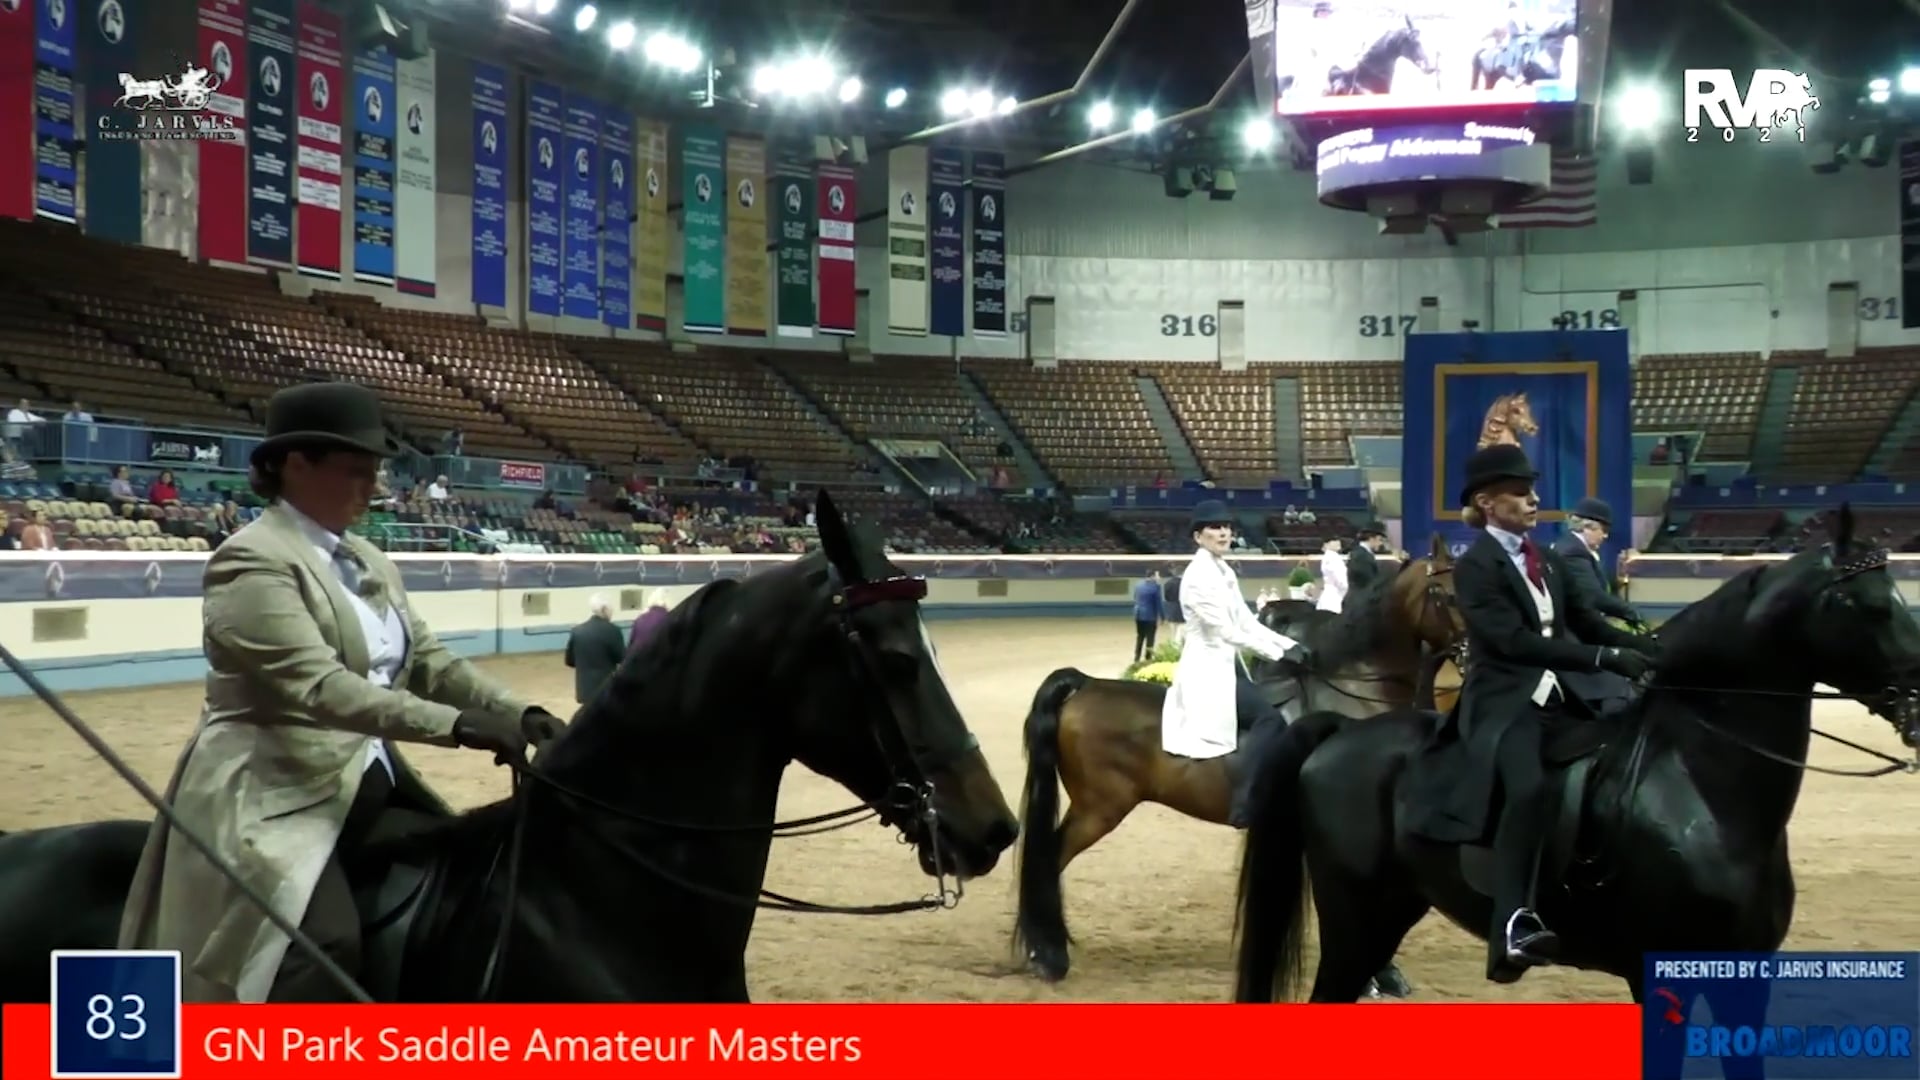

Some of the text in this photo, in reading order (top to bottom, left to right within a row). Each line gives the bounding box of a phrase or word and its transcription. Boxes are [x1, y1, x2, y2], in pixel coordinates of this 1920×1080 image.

[1858, 297, 1899, 321] 31
[1160, 313, 1217, 337] 316
[1359, 314, 1418, 337] 317
